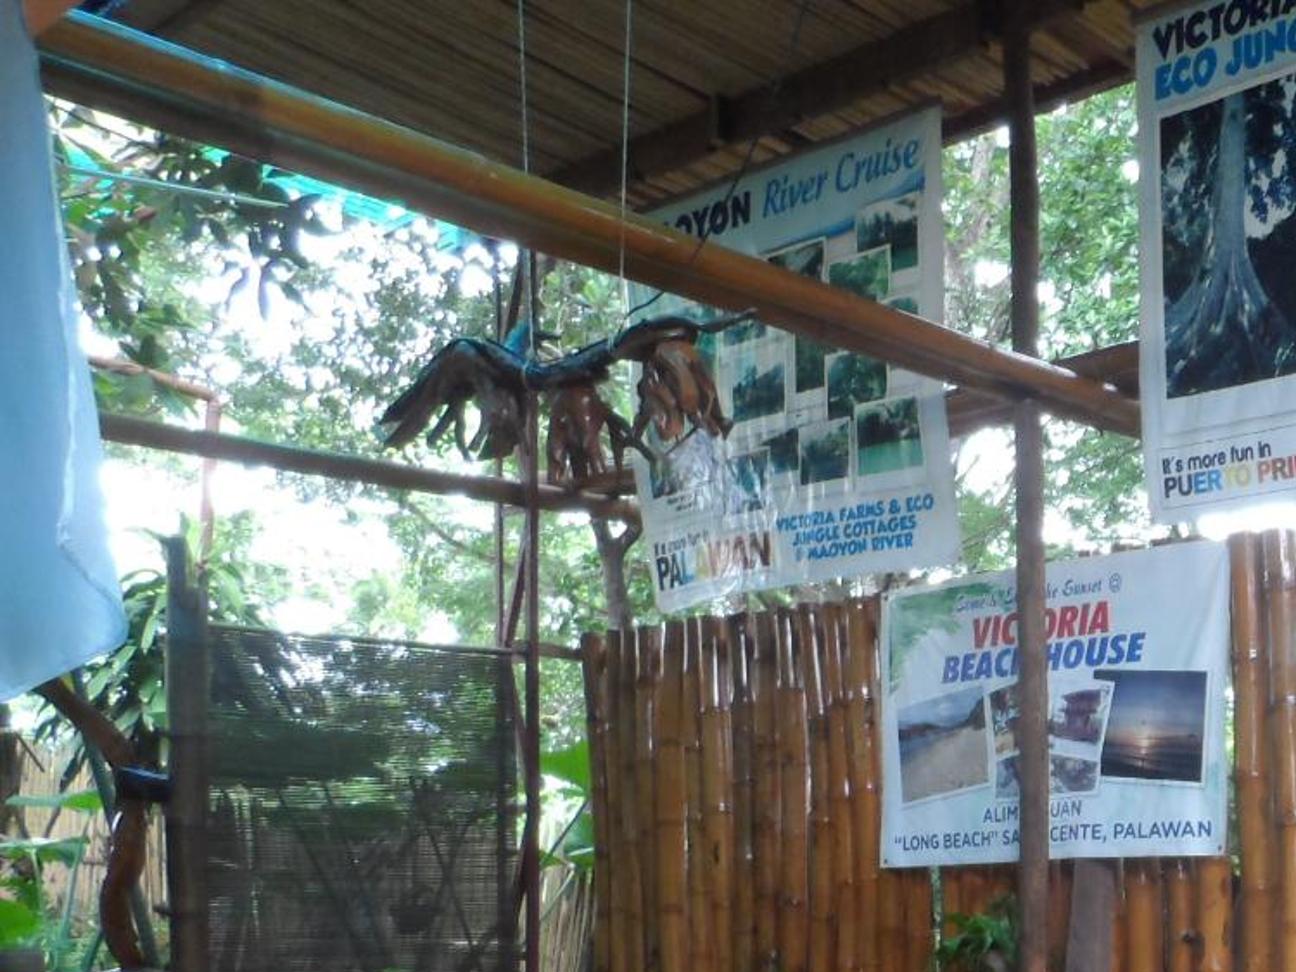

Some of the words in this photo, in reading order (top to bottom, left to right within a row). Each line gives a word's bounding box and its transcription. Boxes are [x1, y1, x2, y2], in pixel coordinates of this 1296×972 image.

[1155, 47, 1217, 101] ECO
[762, 169, 829, 220] River
[835, 137, 920, 194] Cruise
[1188, 450, 1226, 471] more
[1230, 445, 1254, 464] fun
[1163, 466, 1251, 498] PUERTO
[775, 511, 834, 533] VICTORIA
[839, 499, 885, 521] FARMS
[888, 498, 901, 515] &
[906, 493, 934, 512] ECO
[792, 524, 840, 547] JUNGLE
[843, 514, 917, 539] COTTAGES
[656, 531, 771, 592] PALAWAN
[808, 538, 867, 560] MAOYON
[871, 532, 914, 551] RIVER
[972, 601, 1111, 649] VICORIA
[1001, 829, 1020, 846] SA
[1112, 820, 1213, 840] PALAWAN
